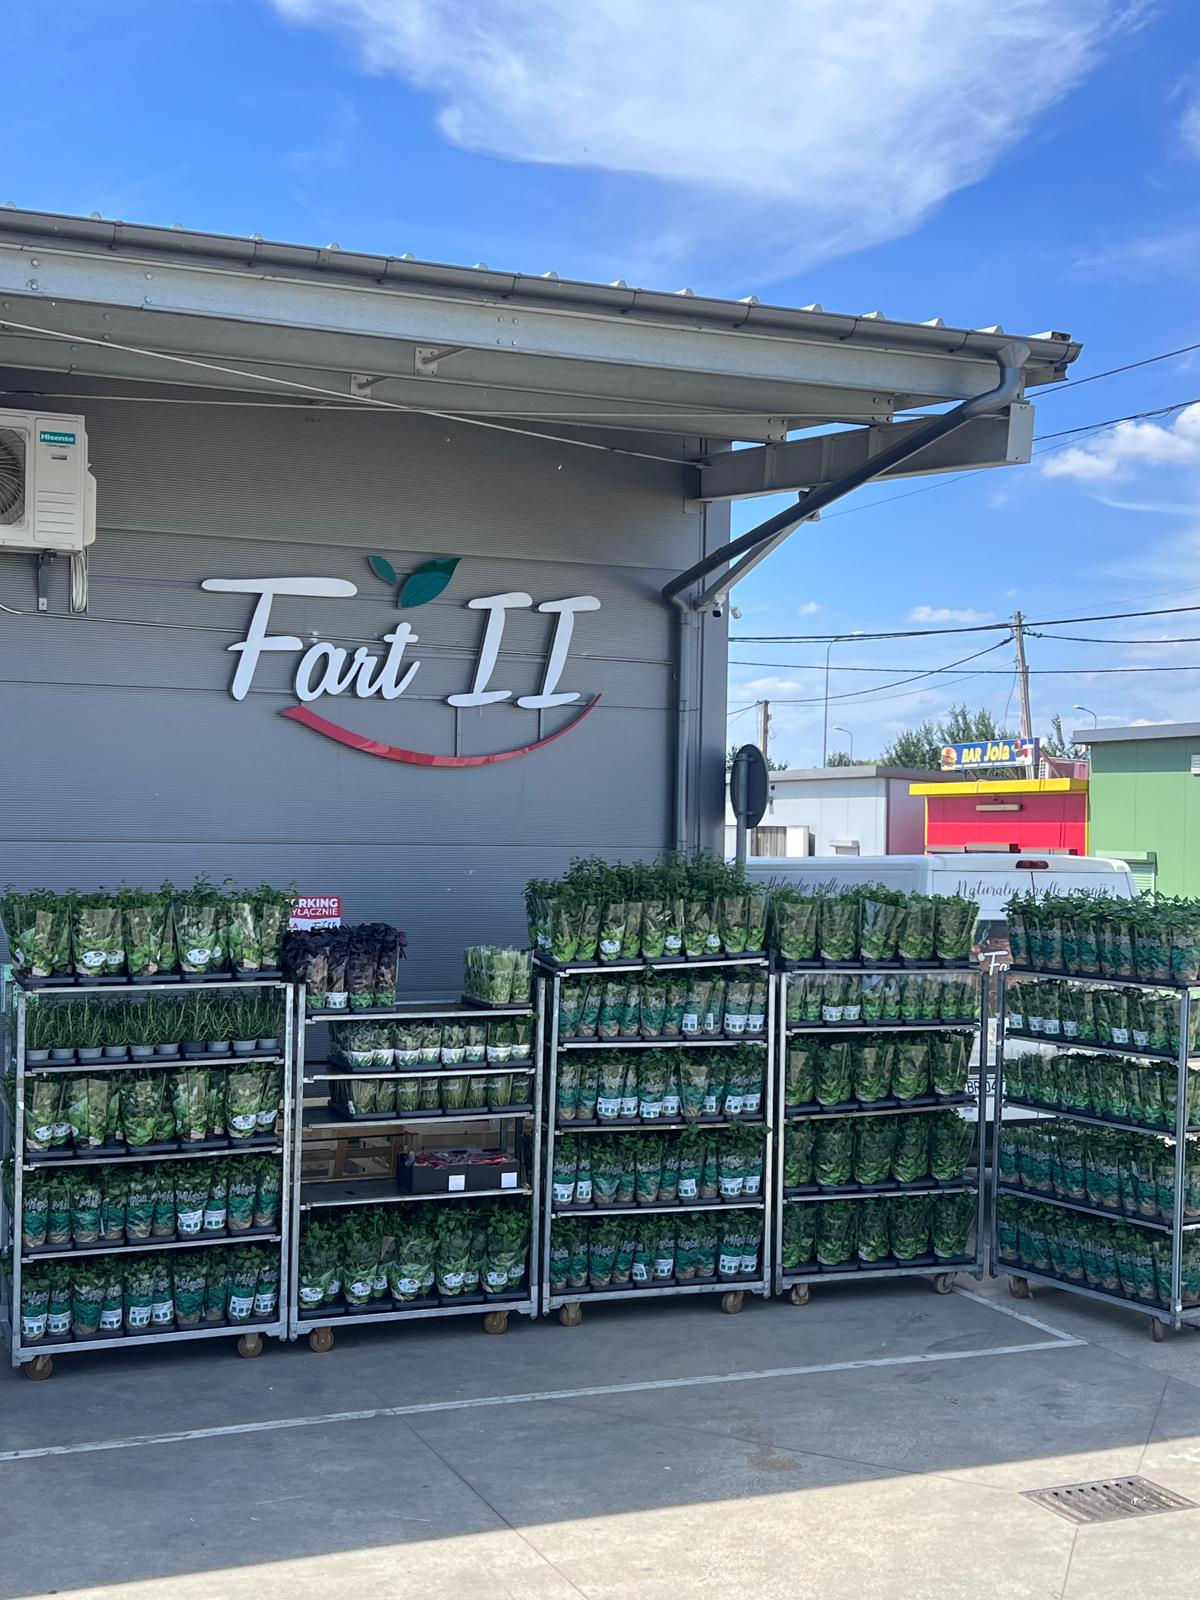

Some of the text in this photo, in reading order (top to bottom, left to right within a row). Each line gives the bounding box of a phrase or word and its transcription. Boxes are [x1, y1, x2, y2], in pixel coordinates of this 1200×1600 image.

[41, 433, 75, 443] Hisense
[200, 576, 602, 709] Fart II
[961, 742, 1010, 763] BAR Jola
[285, 898, 338, 908] RKING
[292, 908, 338, 917] YŁĄCZNIE
[983, 950, 1010, 976] Fa
